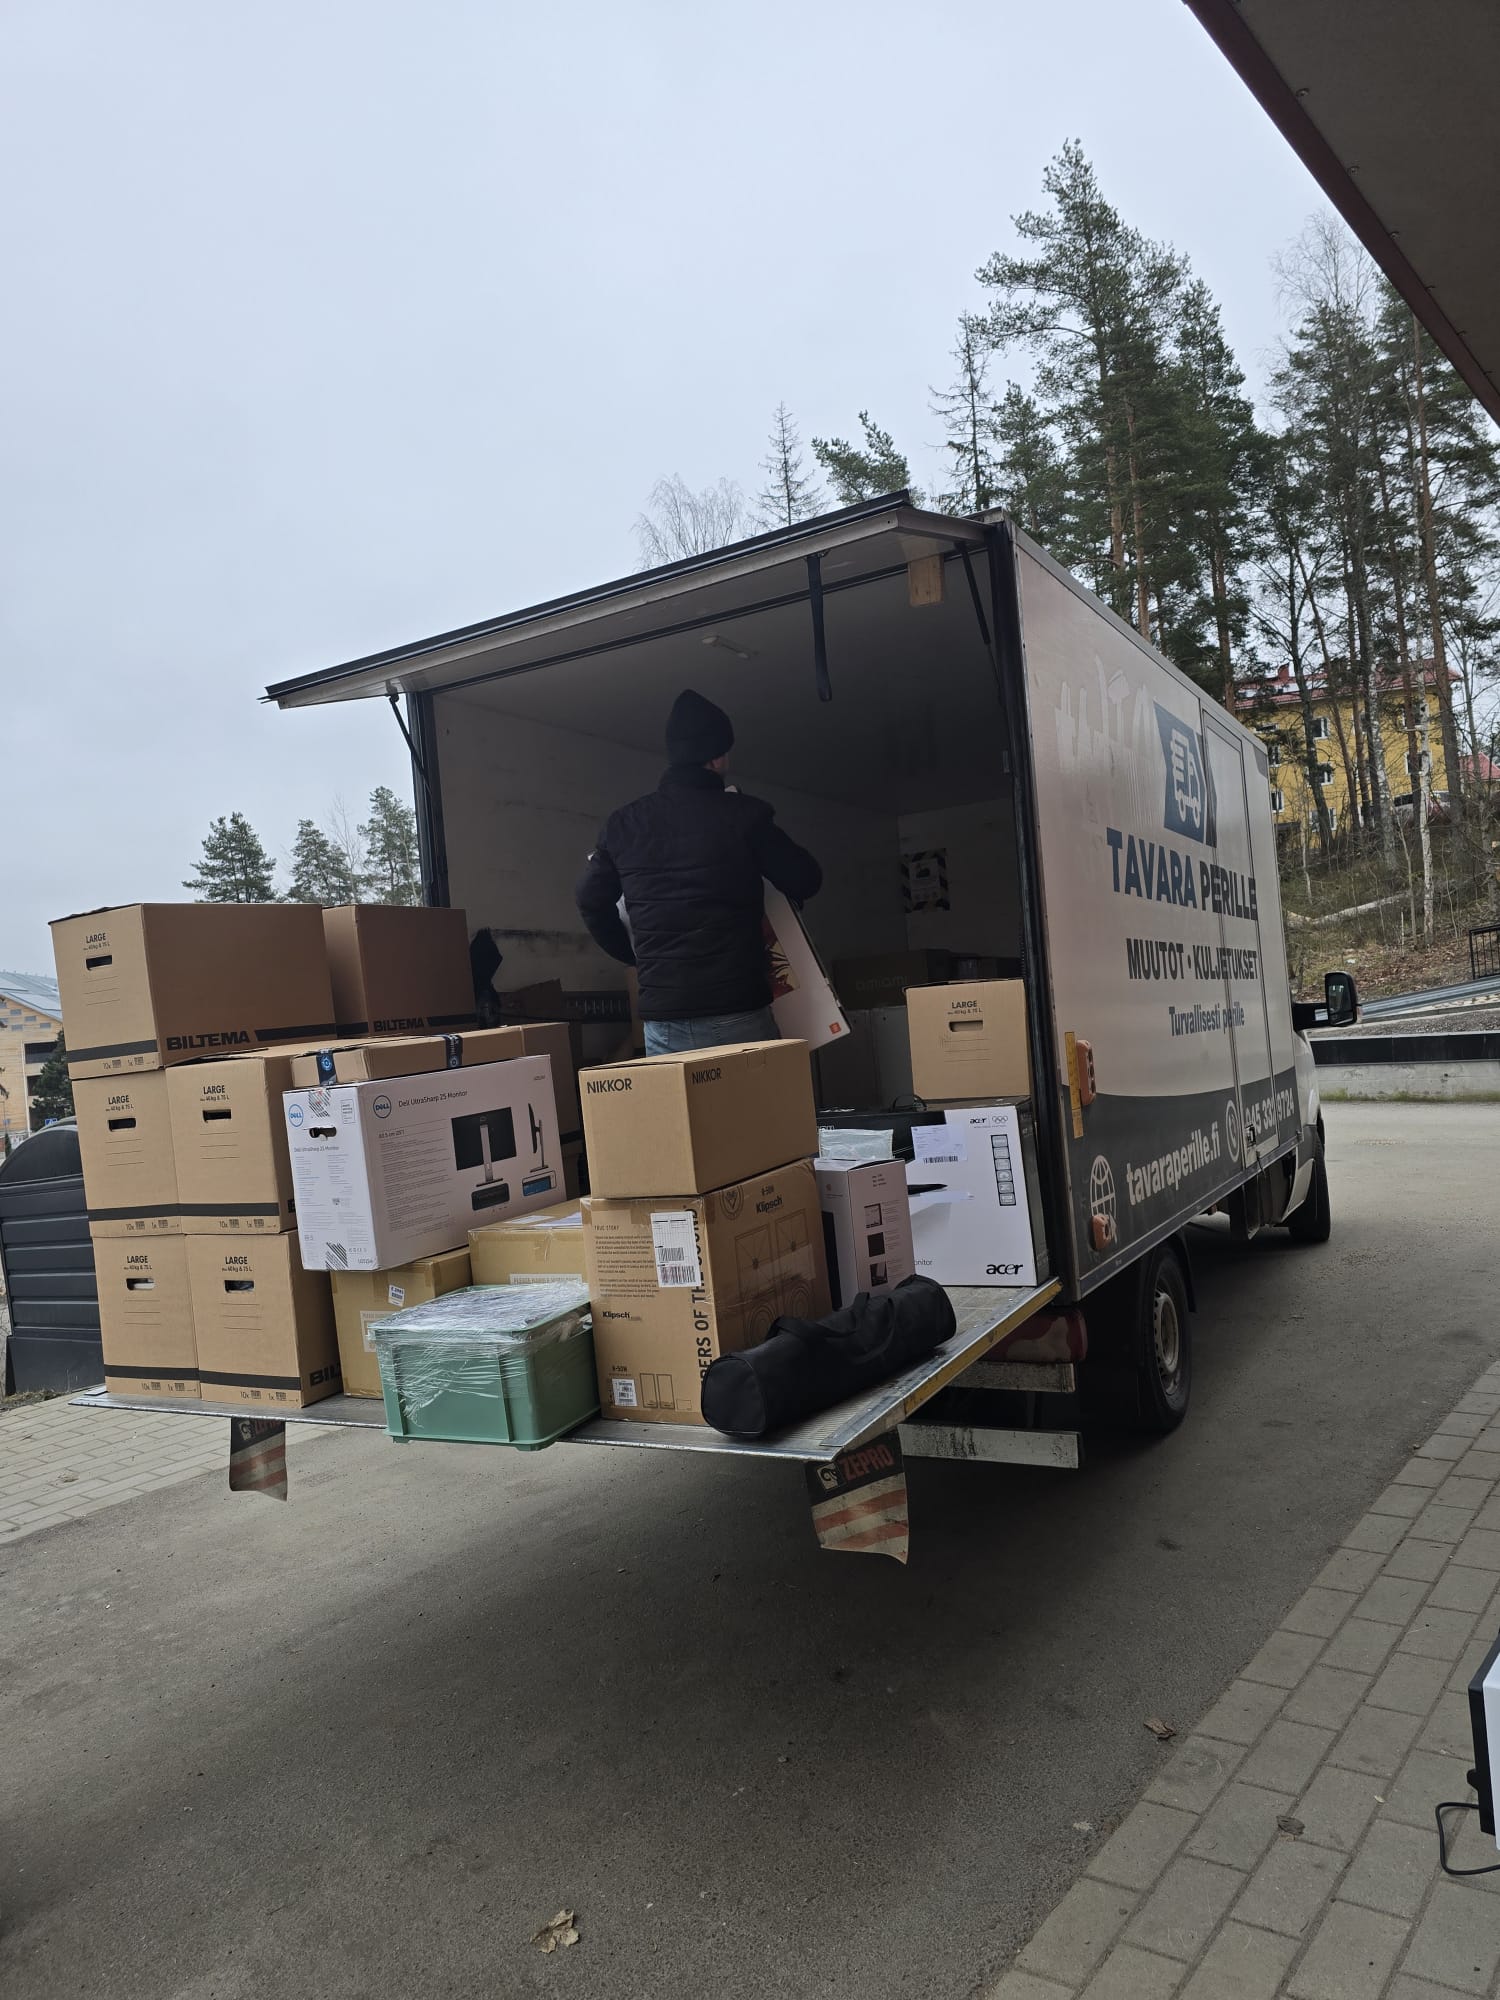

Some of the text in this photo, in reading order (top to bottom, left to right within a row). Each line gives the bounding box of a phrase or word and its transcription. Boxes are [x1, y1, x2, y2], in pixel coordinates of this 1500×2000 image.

[1106, 826, 1258, 921] TAVARA PERILLE
[86, 933, 106, 943] LARGE
[1126, 937, 1258, 981] MUUTOT KULJETUKSET
[951, 1000, 977, 1009] LARGE
[373, 1017, 425, 1033] BILTEMA
[1168, 1003, 1221, 1037] Turvallisesti
[166, 1030, 250, 1051] BILTEMA
[692, 1067, 722, 1085] NIKKOR
[203, 1085, 225, 1095] LARGE
[586, 1078, 633, 1095] NIKKOR
[108, 1095, 129, 1105] LARGE
[398, 1100, 410, 1108] Dell
[410, 1095, 440, 1106] UltraSharp
[447, 1090, 468, 1098] Monitor
[1126, 1120, 1221, 1206] tavaraperille.fi
[756, 1195, 783, 1214] Klipsch
[127, 1255, 148, 1263] LARGE
[225, 1256, 248, 1264] LARGE
[914, 1258, 933, 1266] onitor
[986, 1264, 1024, 1275] acer
[691, 1272, 706, 1304] TH
[602, 1311, 630, 1319] Klipsch
[693, 1309, 710, 1331] OF
[839, 1445, 894, 1480] ZEPRO
